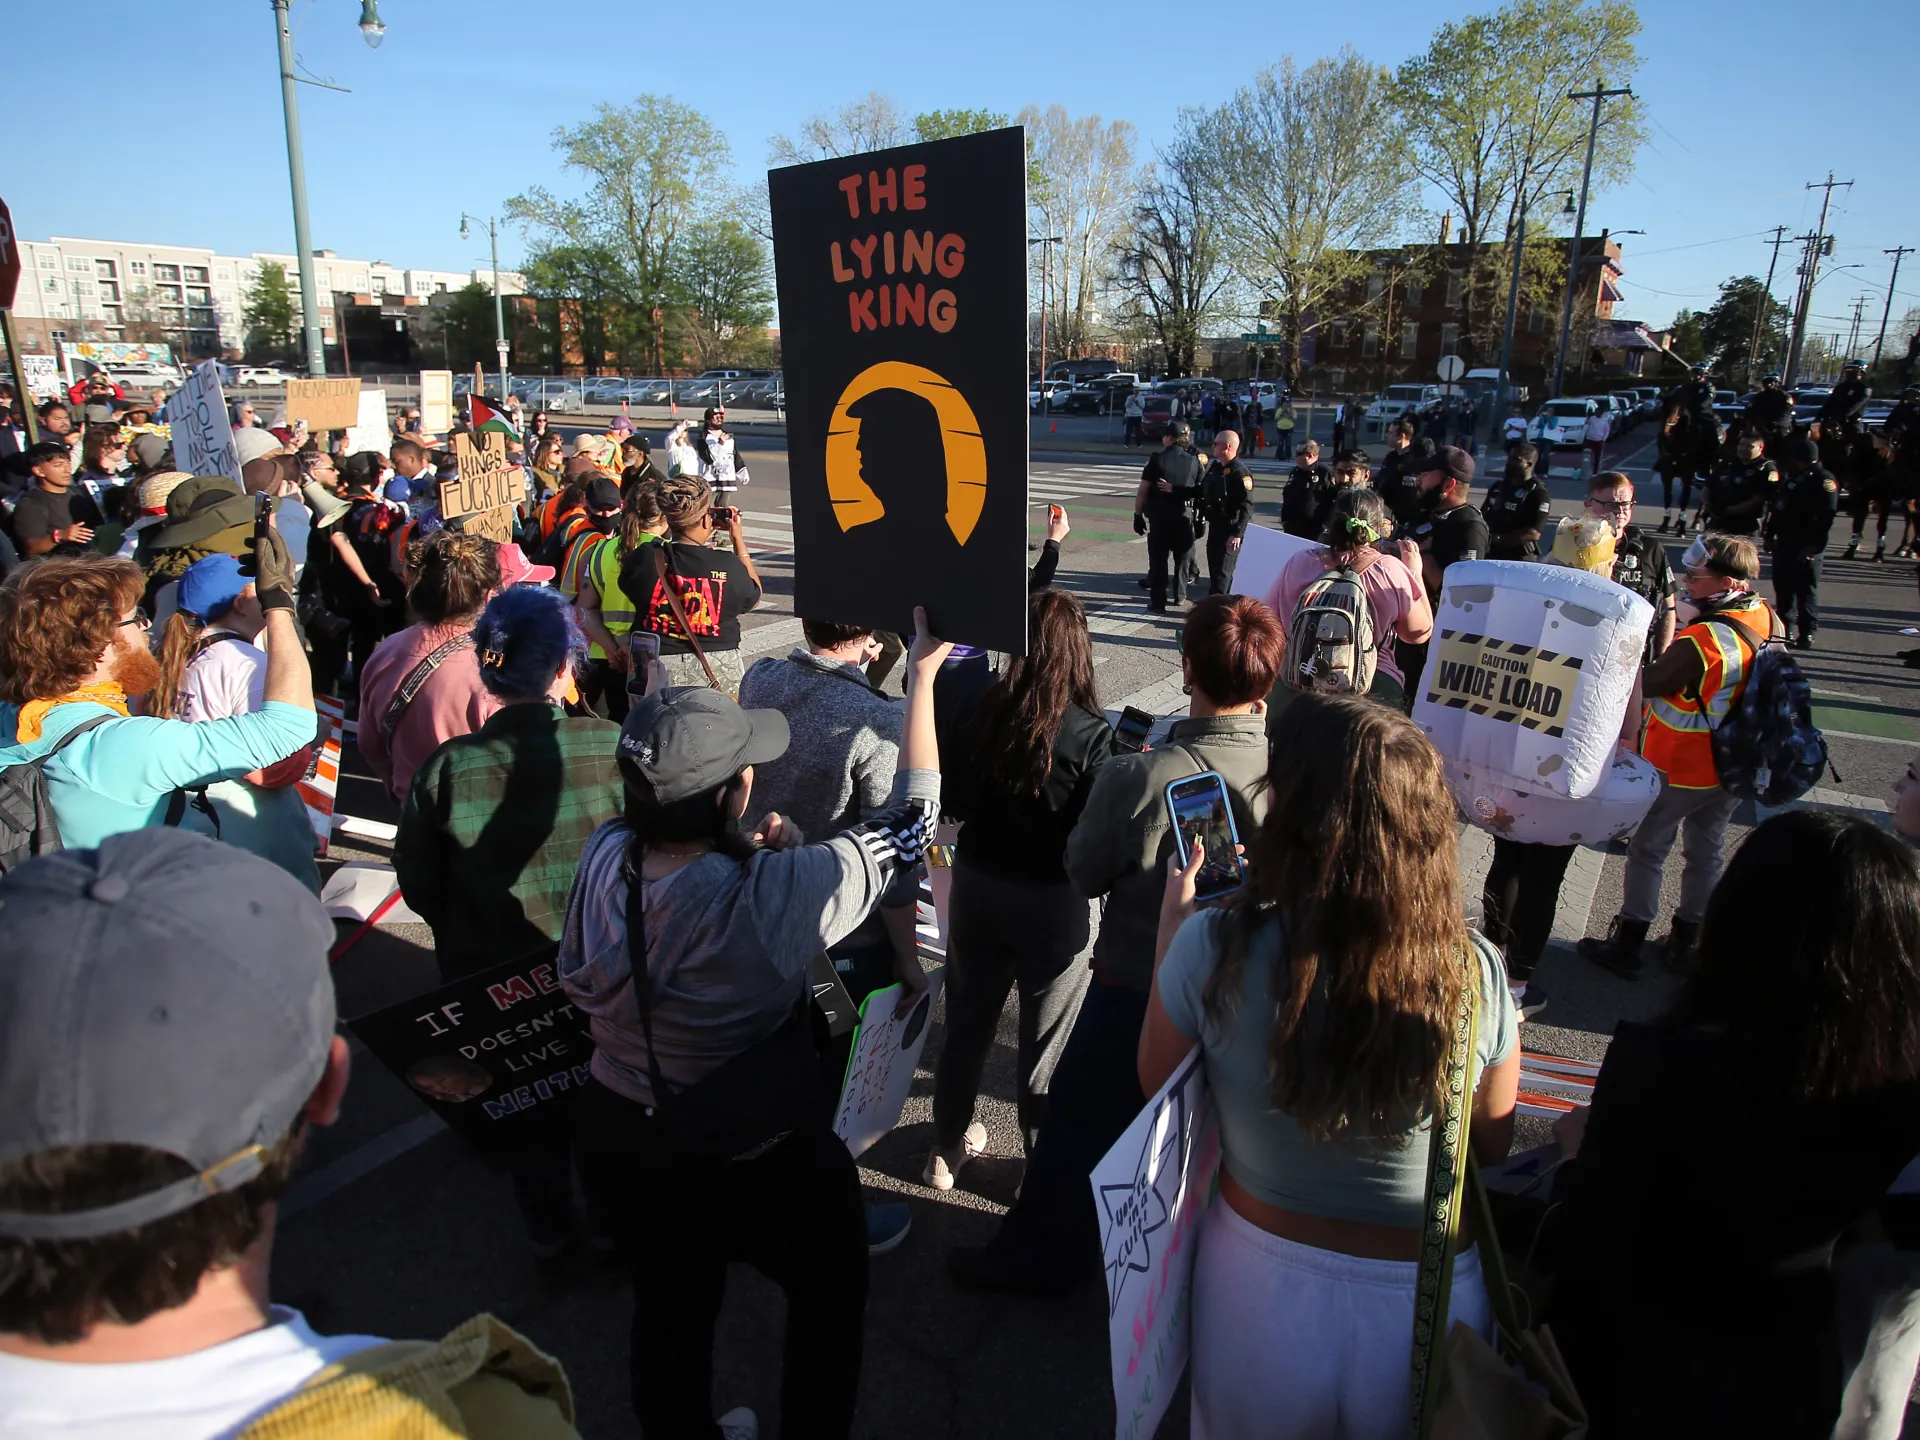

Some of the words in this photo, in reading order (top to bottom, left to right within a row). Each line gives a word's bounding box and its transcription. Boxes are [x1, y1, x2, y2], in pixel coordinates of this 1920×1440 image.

[838, 164, 927, 219] THE
[830, 229, 966, 283] LYING
[849, 283, 958, 333] KING
[313, 379, 357, 398] NATION
[467, 432, 493, 454] NO
[461, 449, 502, 481] KINGS
[444, 473, 493, 517] FUCK
[495, 468, 523, 505] ICE
[711, 570, 728, 579] THE
[1620, 570, 1642, 582] POLICE
[1481, 652, 1529, 675] CAUTION
[1438, 660, 1498, 701] WIDE
[1498, 674, 1563, 718] LOAD
[415, 1001, 464, 1037] IF
[459, 1004, 574, 1060] DOESN'T
[504, 1039, 569, 1072] LIVE
[857, 1020, 888, 1115] Nazis
